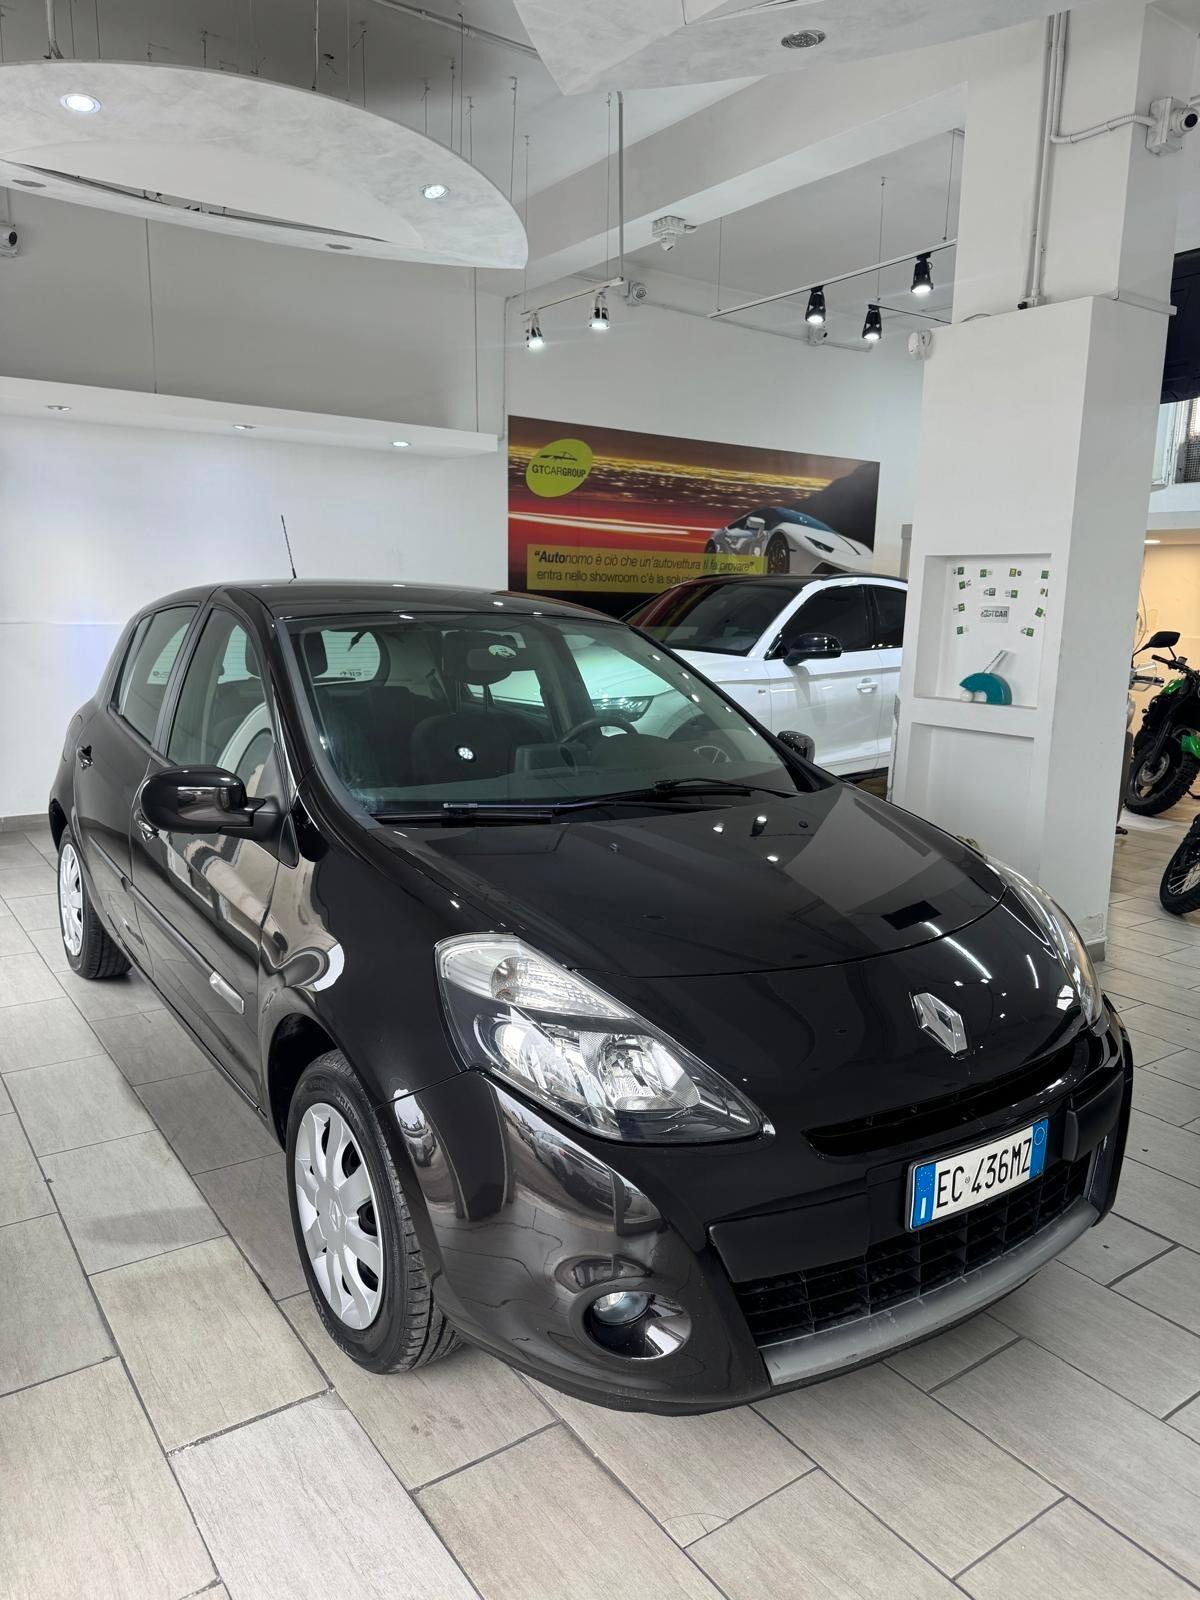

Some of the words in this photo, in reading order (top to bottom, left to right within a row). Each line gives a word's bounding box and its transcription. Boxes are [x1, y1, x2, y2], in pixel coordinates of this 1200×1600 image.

[595, 553, 602, 566] è
[604, 554, 618, 566] ciò
[620, 555, 637, 567] che
[710, 559, 718, 570] fa
[536, 570, 562, 581] entra
[565, 570, 587, 582] nello
[589, 571, 638, 583] showroom
[640, 573, 654, 584] c'è
[656, 573, 664, 584] la
[936, 1165, 965, 1209] EC
[970, 1137, 1033, 1194] 436MZ
